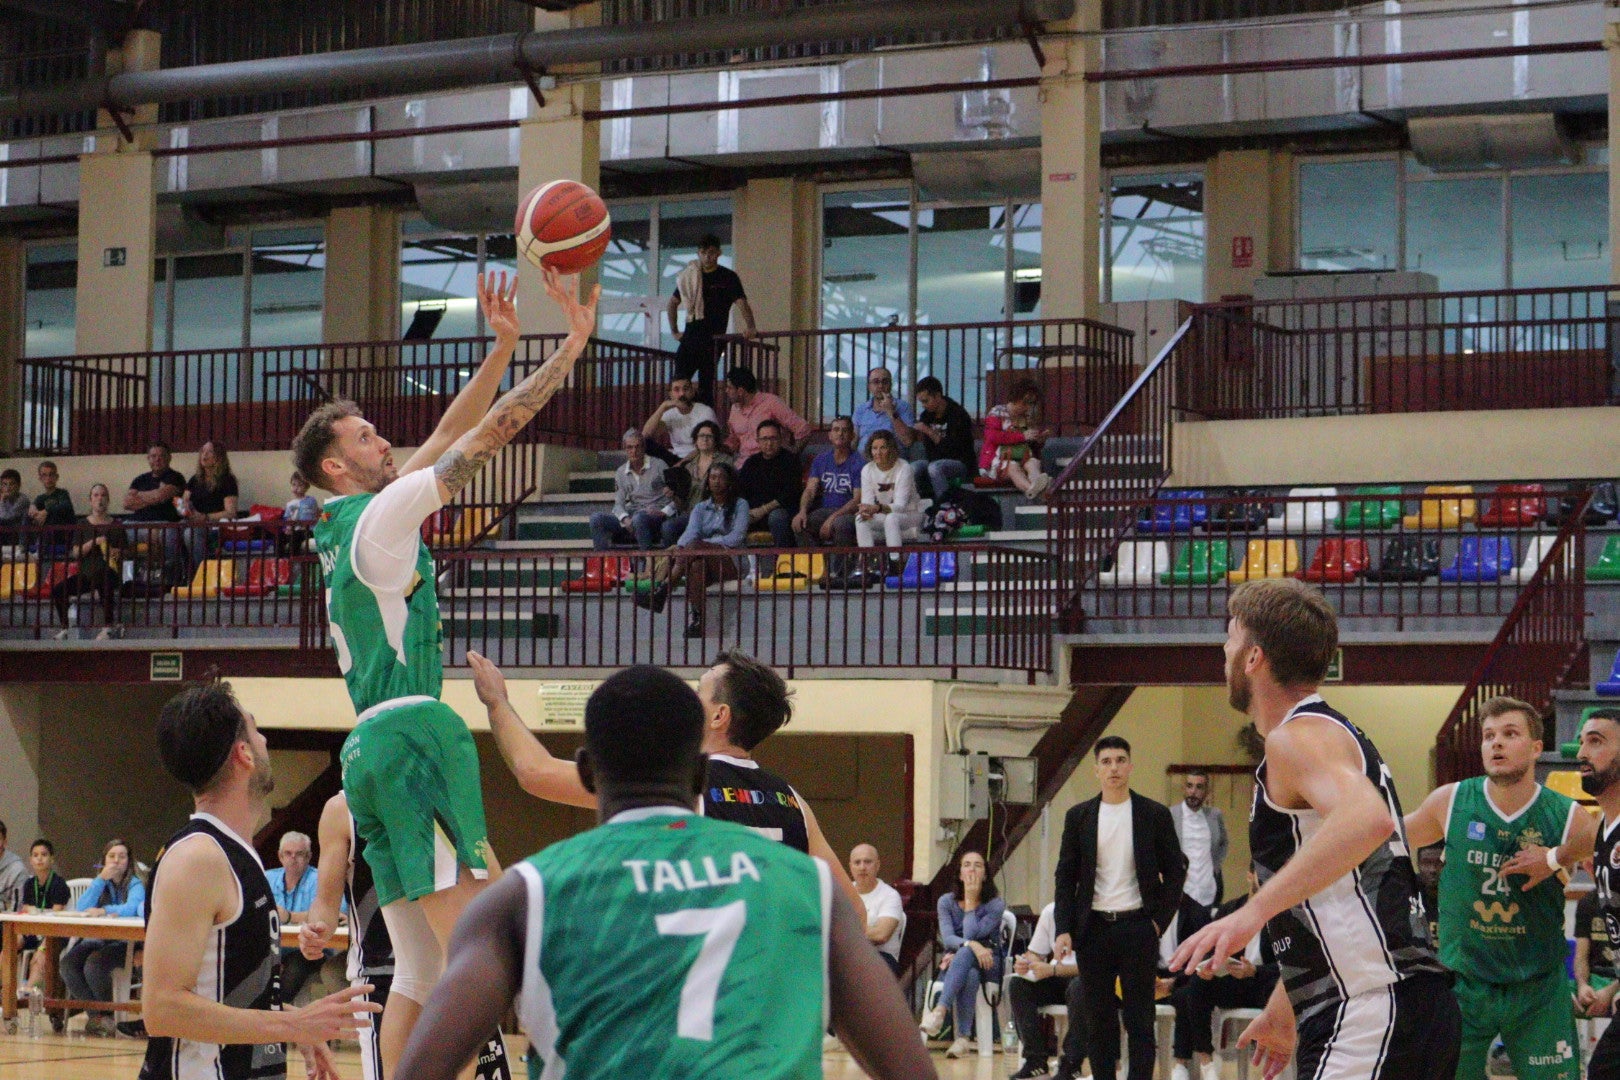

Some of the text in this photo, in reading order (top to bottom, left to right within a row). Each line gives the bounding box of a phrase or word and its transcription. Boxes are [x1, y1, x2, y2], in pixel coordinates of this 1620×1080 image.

[622, 851, 760, 893] TALLA
[1467, 849, 1489, 866] CBI
[1481, 867, 1511, 896] 24
[654, 899, 747, 1041] 7
[1528, 1054, 1563, 1066] suma
